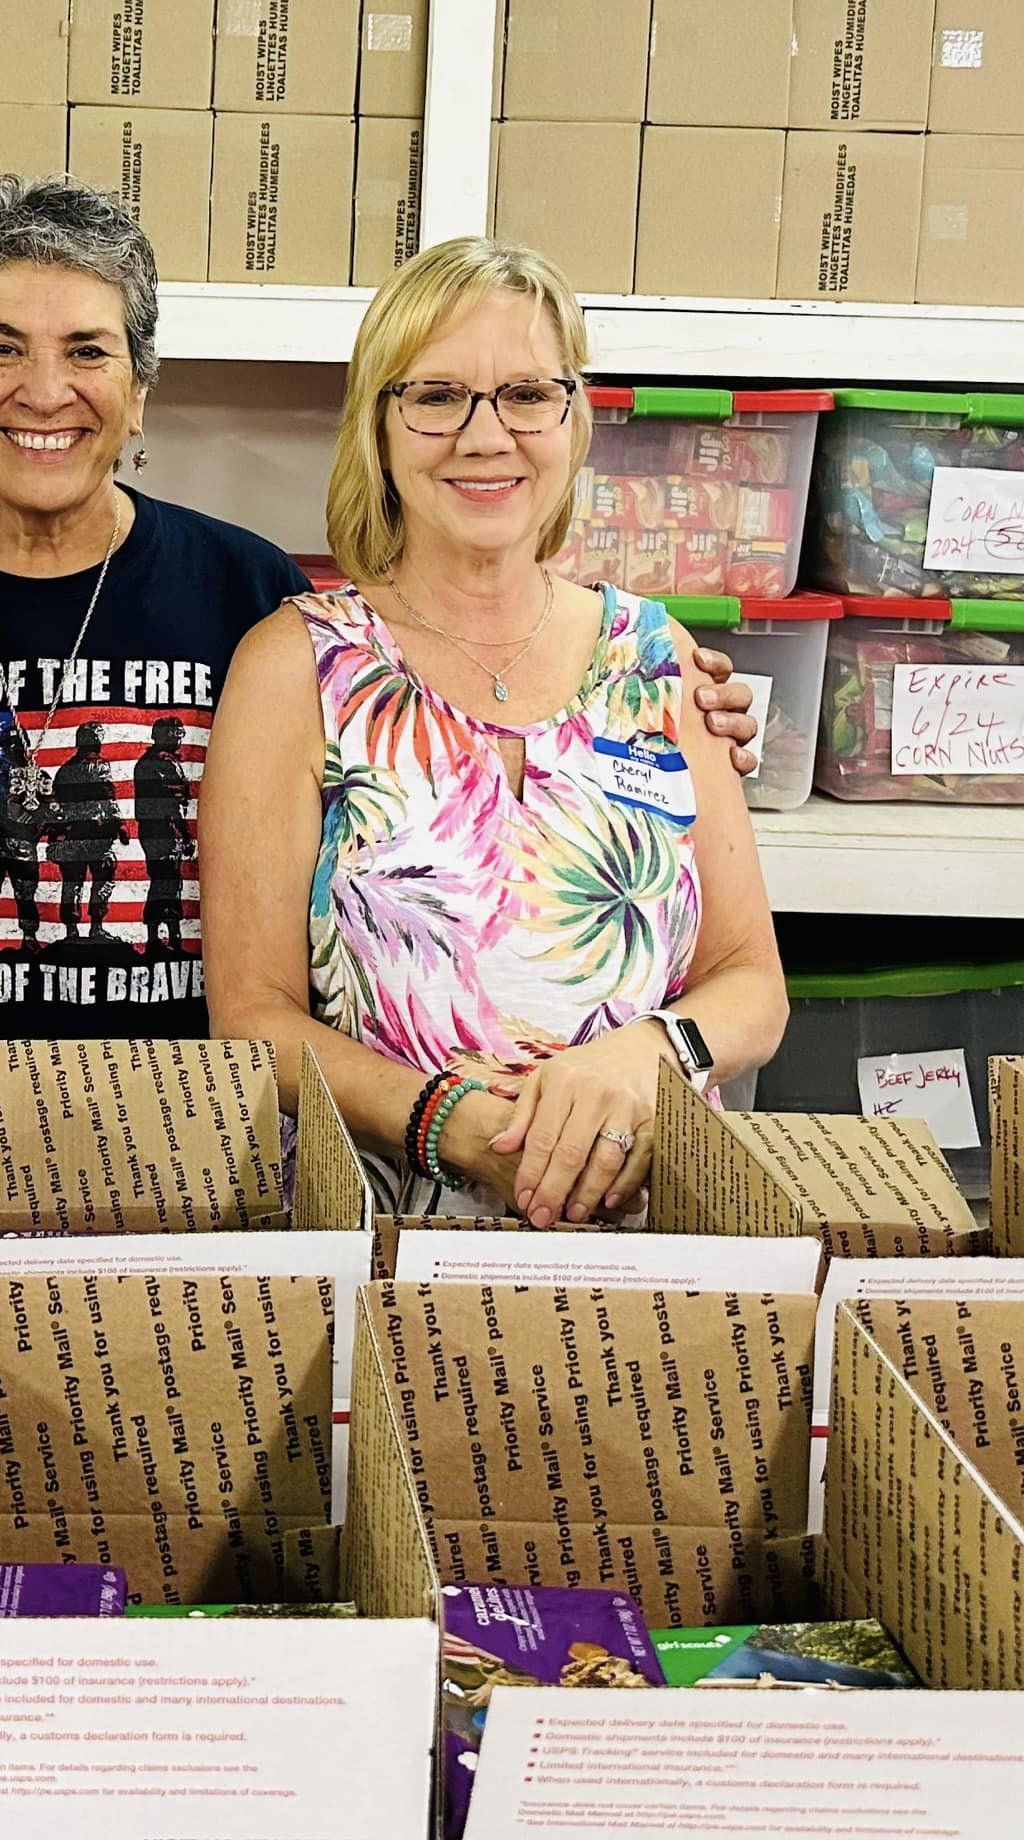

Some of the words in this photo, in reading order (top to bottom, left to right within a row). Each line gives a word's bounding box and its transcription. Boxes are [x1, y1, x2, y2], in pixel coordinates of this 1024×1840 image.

[257, 20, 267, 59] WIPES
[833, 40, 843, 78] WIPES
[256, 61, 264, 101] MOIST
[266, 33, 276, 101] LINGETTES
[277, 35, 287, 102] TOALLITAS
[841, 52, 852, 120] LINGETTES
[851, 55, 863, 120] TOALLITAS
[831, 81, 840, 120] MOIST
[269, 143, 280, 202] HUMEDAS
[844, 165, 856, 223] HUMEDAS
[247, 191, 257, 230] WIPES
[820, 213, 832, 250] WIPES
[246, 232, 255, 270] MOIST
[256, 203, 267, 271] LINGETTES
[266, 206, 278, 272] TOALLITAS
[829, 225, 841, 291] LINGETTES
[839, 227, 852, 291] TOALLITAS
[818, 254, 829, 291] MOIST
[38, 658, 109, 705] THE
[126, 662, 213, 706] FREE
[613, 760, 652, 783] Cheryl
[628, 745, 656, 761] Hello
[896, 740, 952, 767] CORN
[614, 775, 669, 804] Ramirez
[38, 962, 96, 1004] THE
[108, 965, 206, 1003] BRAVE
[21, 1040, 42, 1096] required
[77, 1044, 95, 1093] Service
[875, 1068, 912, 1088] BEEF
[915, 1064, 961, 1089] JERKY
[56, 1070, 74, 1119] Priority
[35, 1099, 56, 1154] postage
[2, 1155, 19, 1201] Thank
[97, 1136, 116, 1186] Priority
[424, 1302, 441, 1337] you
[388, 1314, 411, 1384] Priority
[428, 1342, 449, 1402] Thank
[897, 1322, 918, 1380] Thank
[921, 1334, 949, 1414] required
[453, 1356, 479, 1436] required
[532, 1364, 553, 1436] Service
[1000, 1342, 1021, 1412] Service
[401, 1389, 419, 1442] using
[500, 1401, 522, 1472] Priority
[968, 1378, 990, 1448] Priority
[411, 1447, 424, 1475] for
[471, 1442, 496, 1517] postage
[0, 1657, 55, 1668] specified
[57, 1657, 74, 1667] for
[77, 1657, 130, 1667] domestic
[657, 1641, 679, 1651] girl
[681, 1640, 722, 1648] scouts
[31, 1675, 60, 1687] $100
[63, 1676, 76, 1686] of
[78, 1676, 135, 1686] insurance
